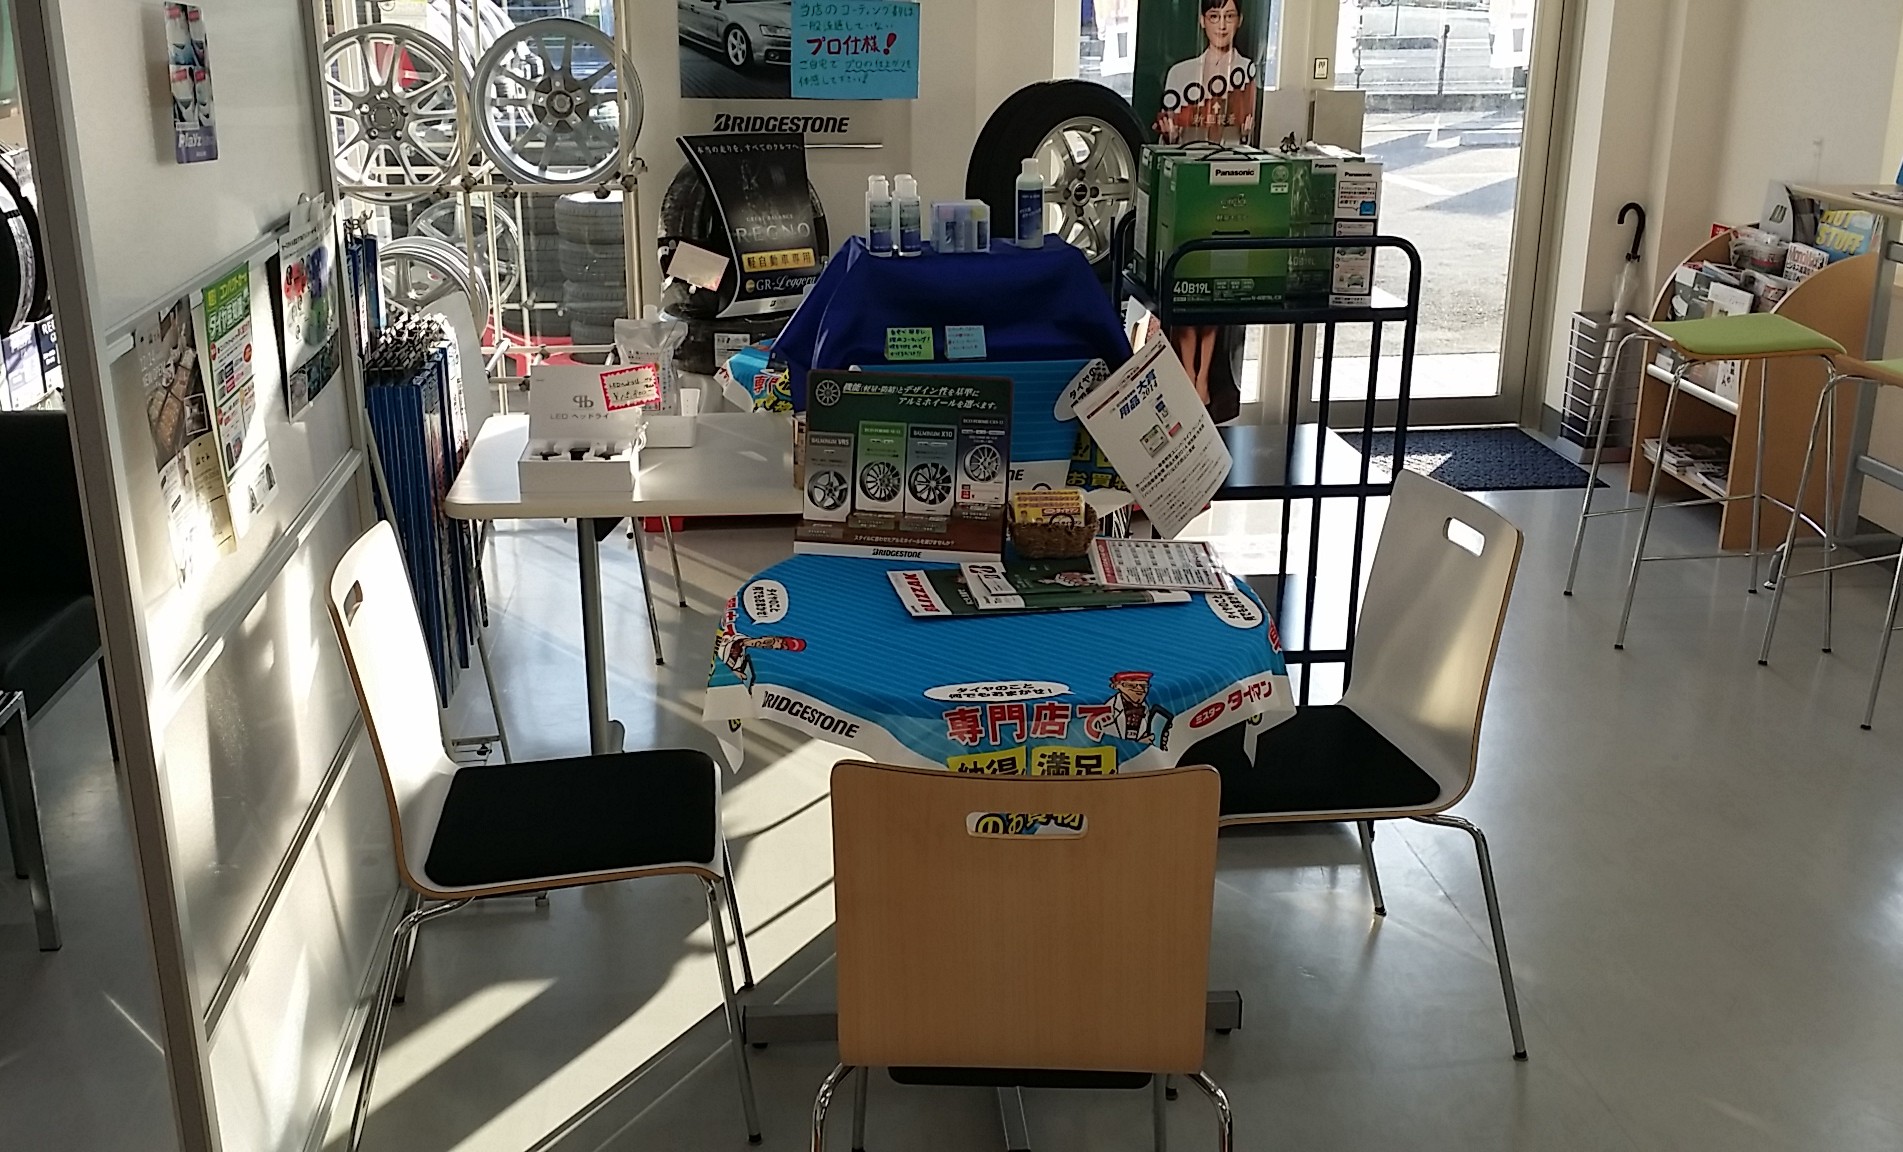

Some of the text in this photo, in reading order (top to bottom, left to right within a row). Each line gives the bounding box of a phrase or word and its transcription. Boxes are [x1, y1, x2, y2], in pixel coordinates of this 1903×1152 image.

[713, 114, 849, 133] BRIDGESTONE
[1215, 168, 1254, 176] Panasonic
[735, 222, 811, 243] REGNO
[746, 252, 813, 269] 軽自動車専用
[1173, 281, 1211, 294] 40B19L
[872, 549, 922, 558] BRIDGESTONE
[903, 573, 940, 612] BLIZZAK
[957, 683, 1034, 693] タイヤのこと
[943, 702, 1114, 745] 専門店で
[1195, 706, 1221, 724] ミスター
